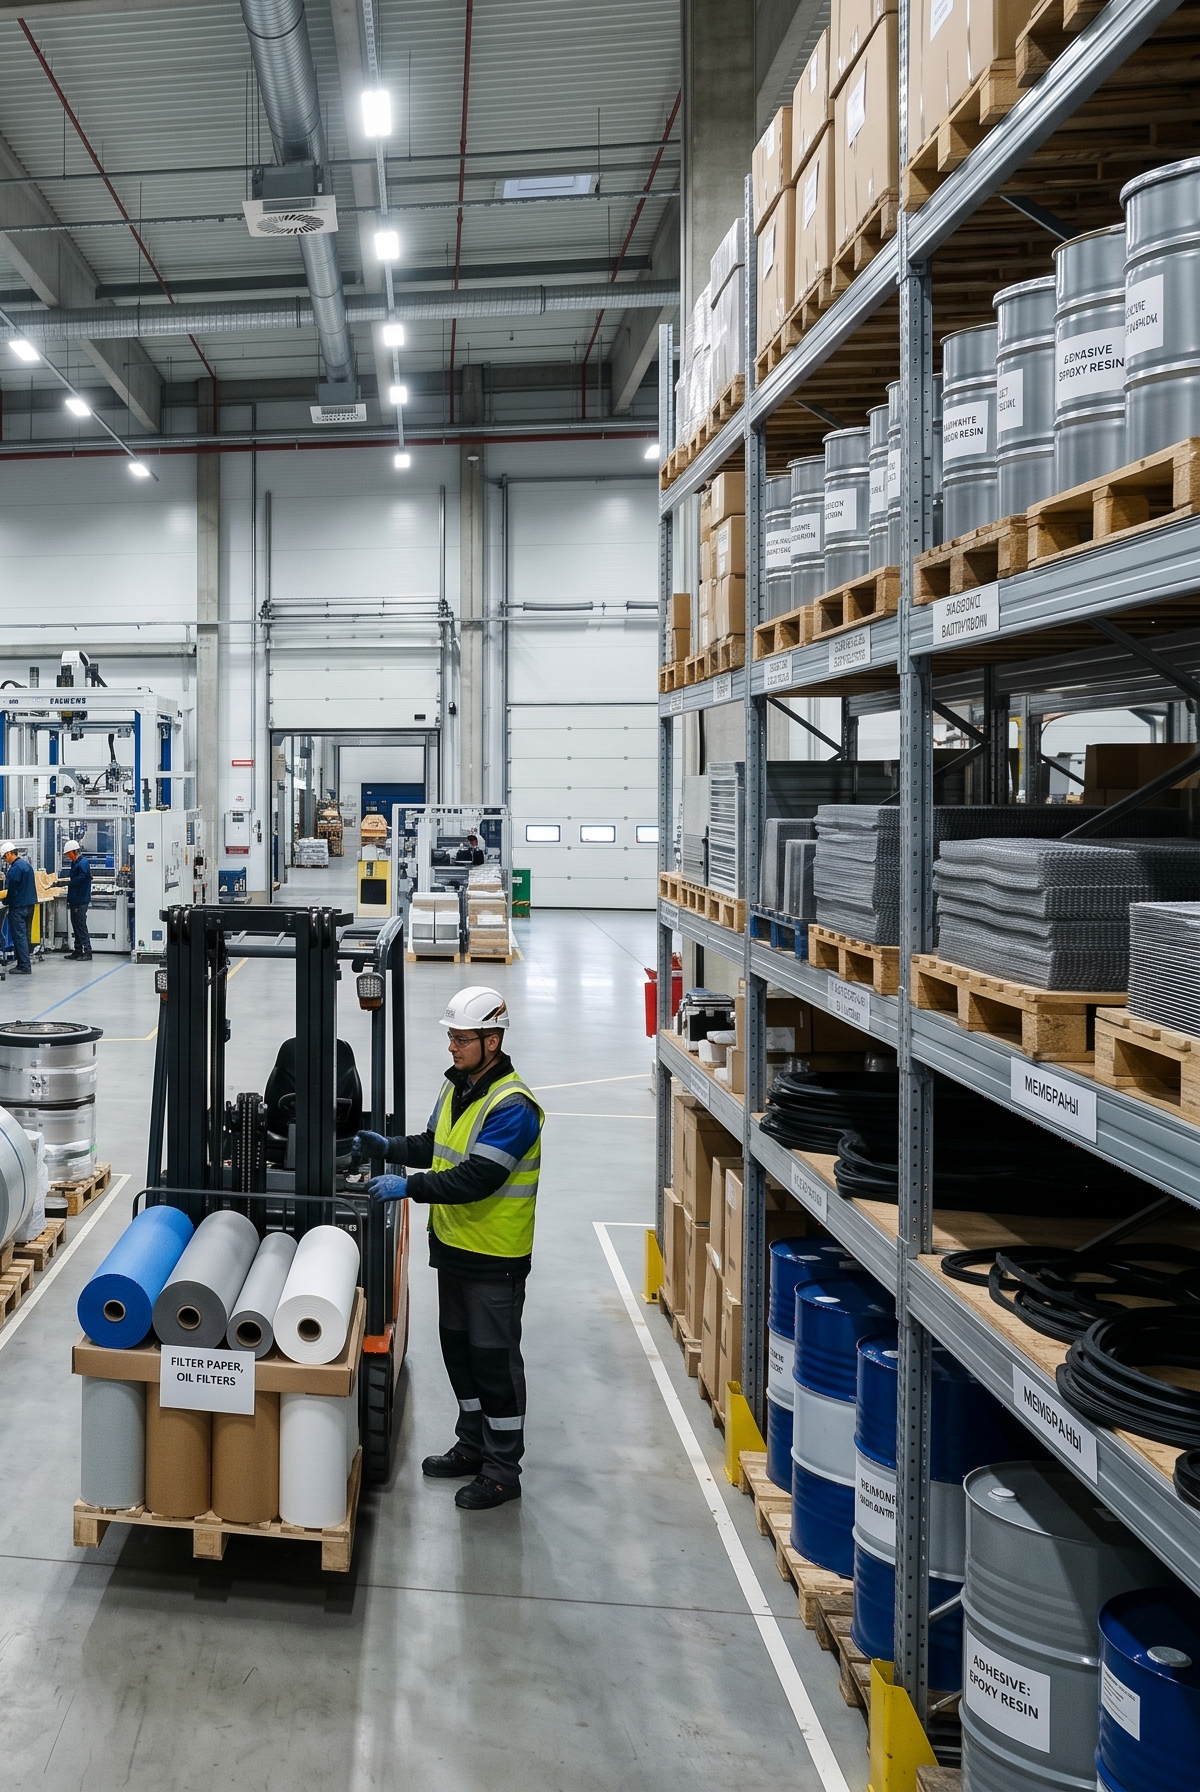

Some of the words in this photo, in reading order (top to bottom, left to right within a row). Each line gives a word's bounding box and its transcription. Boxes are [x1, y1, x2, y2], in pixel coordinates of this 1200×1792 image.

[1090, 358, 1124, 372] RESIN
[960, 427, 984, 438] RESIN
[171, 1356, 204, 1368] FILTER
[206, 1360, 244, 1374] PAPER,
[176, 1372, 194, 1382] OIL
[196, 1374, 236, 1386] FILTERS
[973, 1654, 1030, 1696] ADHESIVE:
[970, 1670, 998, 1699] EPOXY
[1001, 1692, 1038, 1720] RESIN
